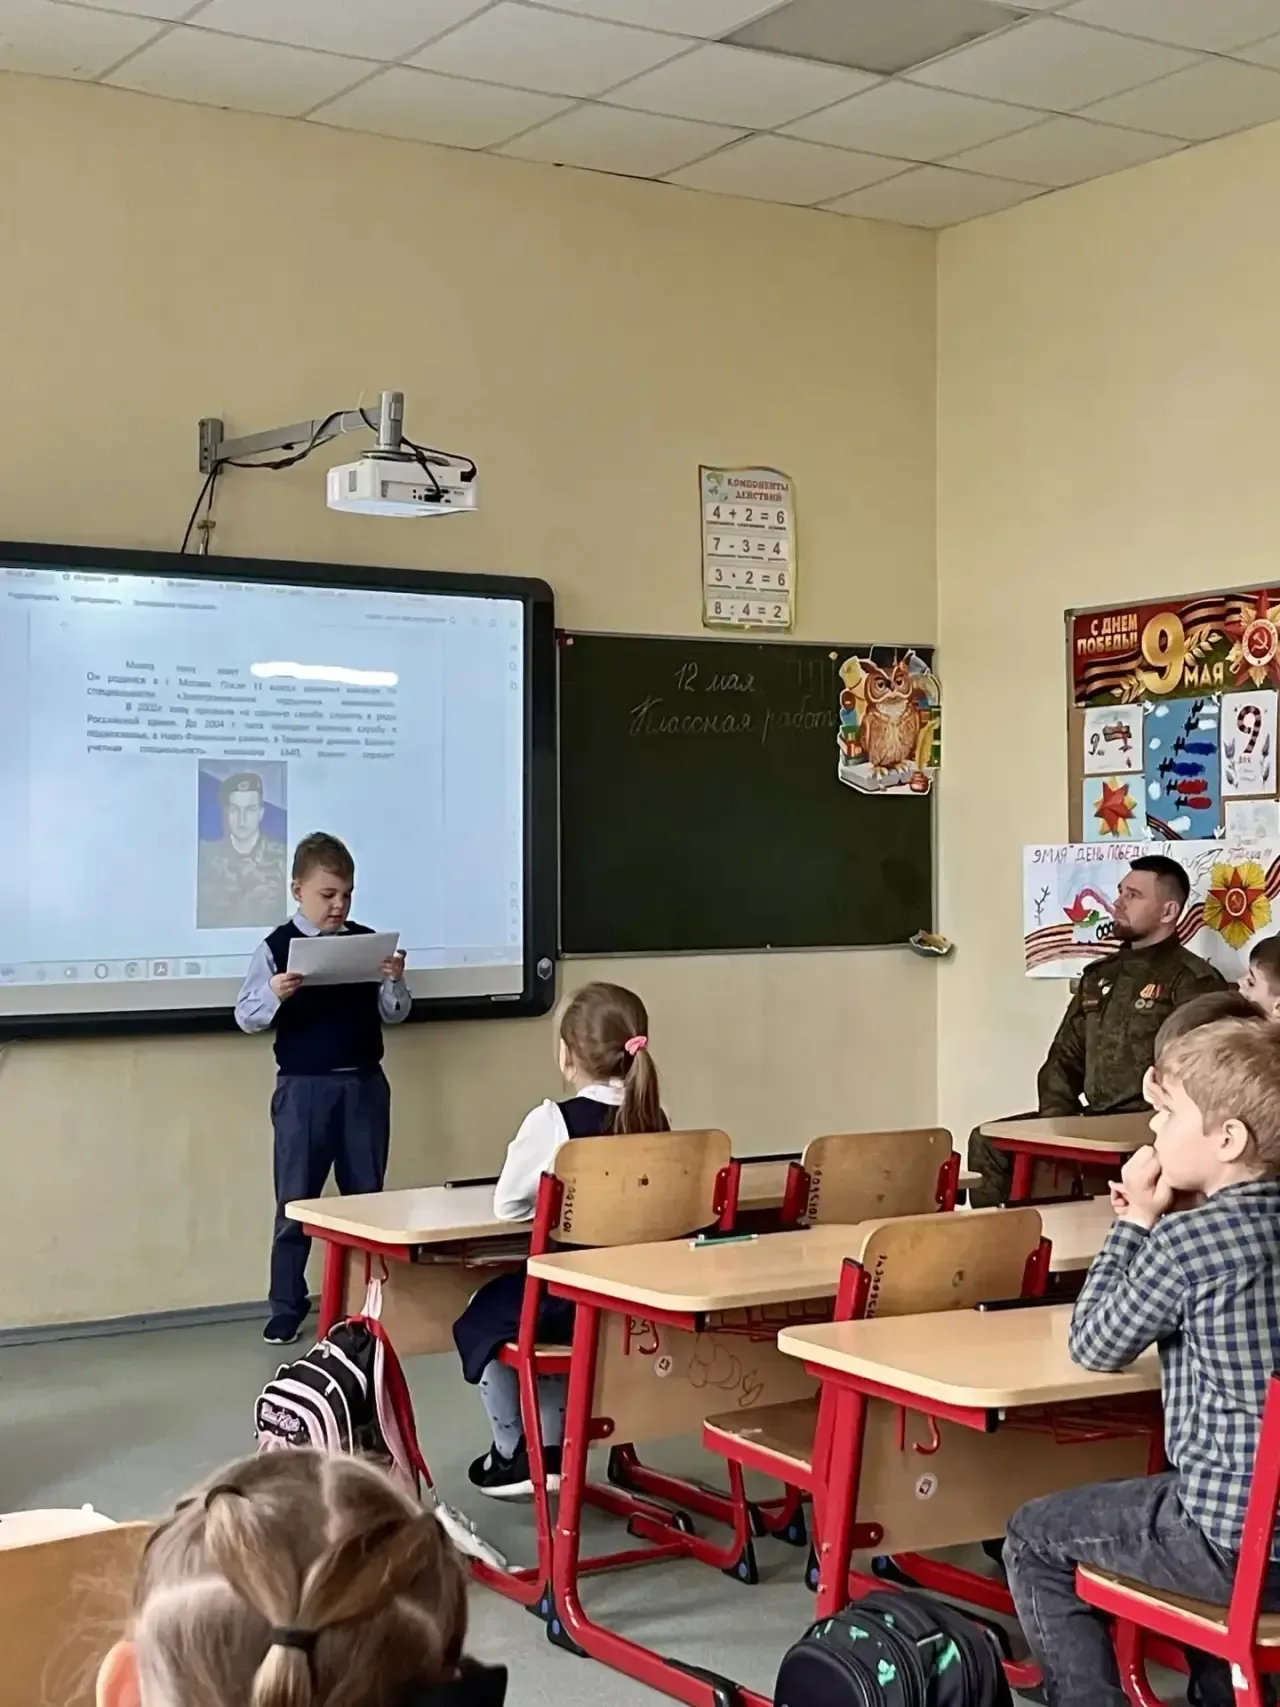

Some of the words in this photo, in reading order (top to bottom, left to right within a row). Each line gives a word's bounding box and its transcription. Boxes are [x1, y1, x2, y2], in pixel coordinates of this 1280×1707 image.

[727, 478, 789, 491] КОМПОНЕНТЫ
[735, 490, 783, 502] ДЕЙСТВИЙ
[713, 506, 721, 519] 4
[729, 508, 737, 519] +
[745, 508, 753, 522] 2
[760, 512, 769, 520] =
[777, 511, 785, 525] 6
[713, 537, 721, 551] 7
[742, 539, 750, 553] 3
[757, 543, 765, 551] =
[773, 541, 781, 555] 4
[715, 569, 723, 582] 3
[745, 571, 754, 585] 2
[762, 575, 771, 583] =
[778, 573, 786, 586] 6
[714, 601, 722, 615] 8
[742, 603, 750, 616] 4
[757, 607, 766, 615] =
[773, 605, 782, 619] 2
[1090, 619, 1099, 636] С
[1101, 613, 1138, 635] ДНЕМ
[1142, 612, 1185, 695] 9
[1184, 662, 1224, 688] МАЯ
[675, 661, 699, 692] 12
[705, 672, 757, 693] мая
[630, 693, 755, 736] Классная
[761, 694, 838, 747] работ
[1237, 704, 1262, 754] 9
[1075, 846, 1105, 862] ДЕНЬ
